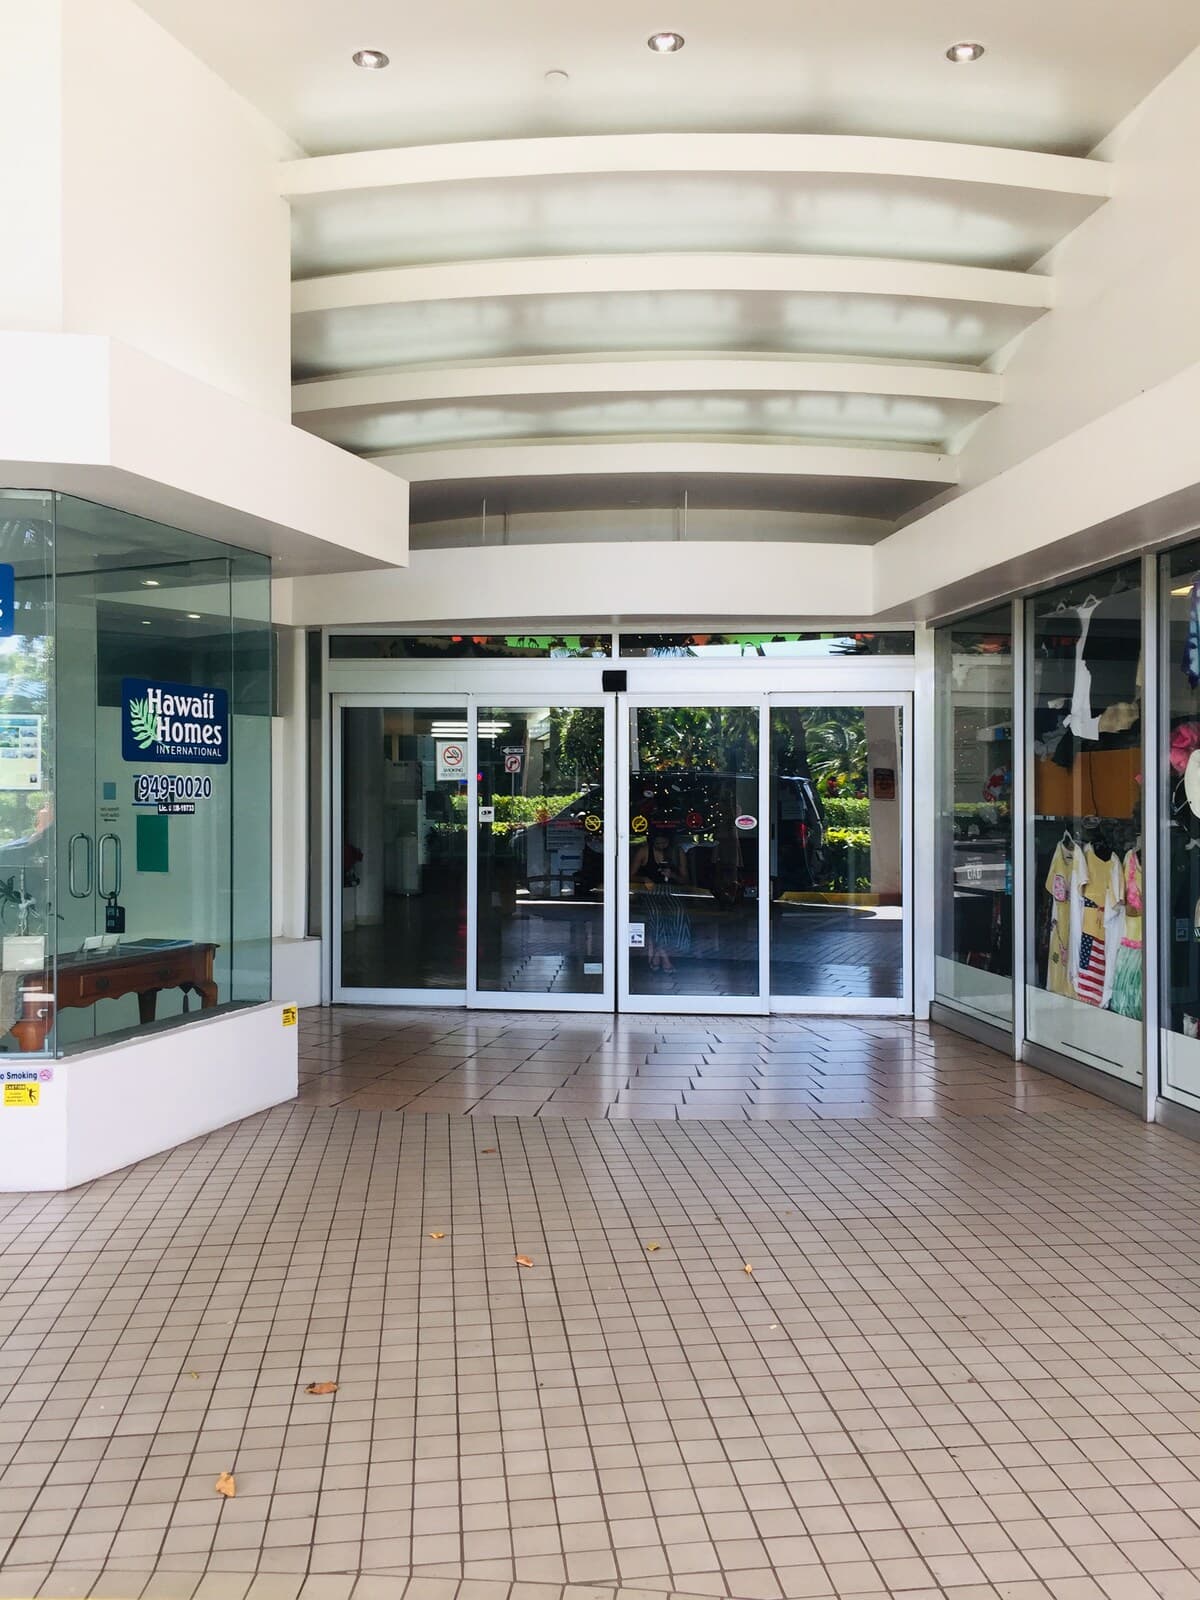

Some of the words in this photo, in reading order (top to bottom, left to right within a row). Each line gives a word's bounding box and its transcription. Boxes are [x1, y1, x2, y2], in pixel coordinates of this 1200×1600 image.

[147, 688, 214, 719] Hawaii
[156, 717, 222, 745] Homes
[156, 745, 222, 757] INTERNATIONAL
[139, 775, 212, 799] 949-0020
[7, 1072, 37, 1080] Smoking
